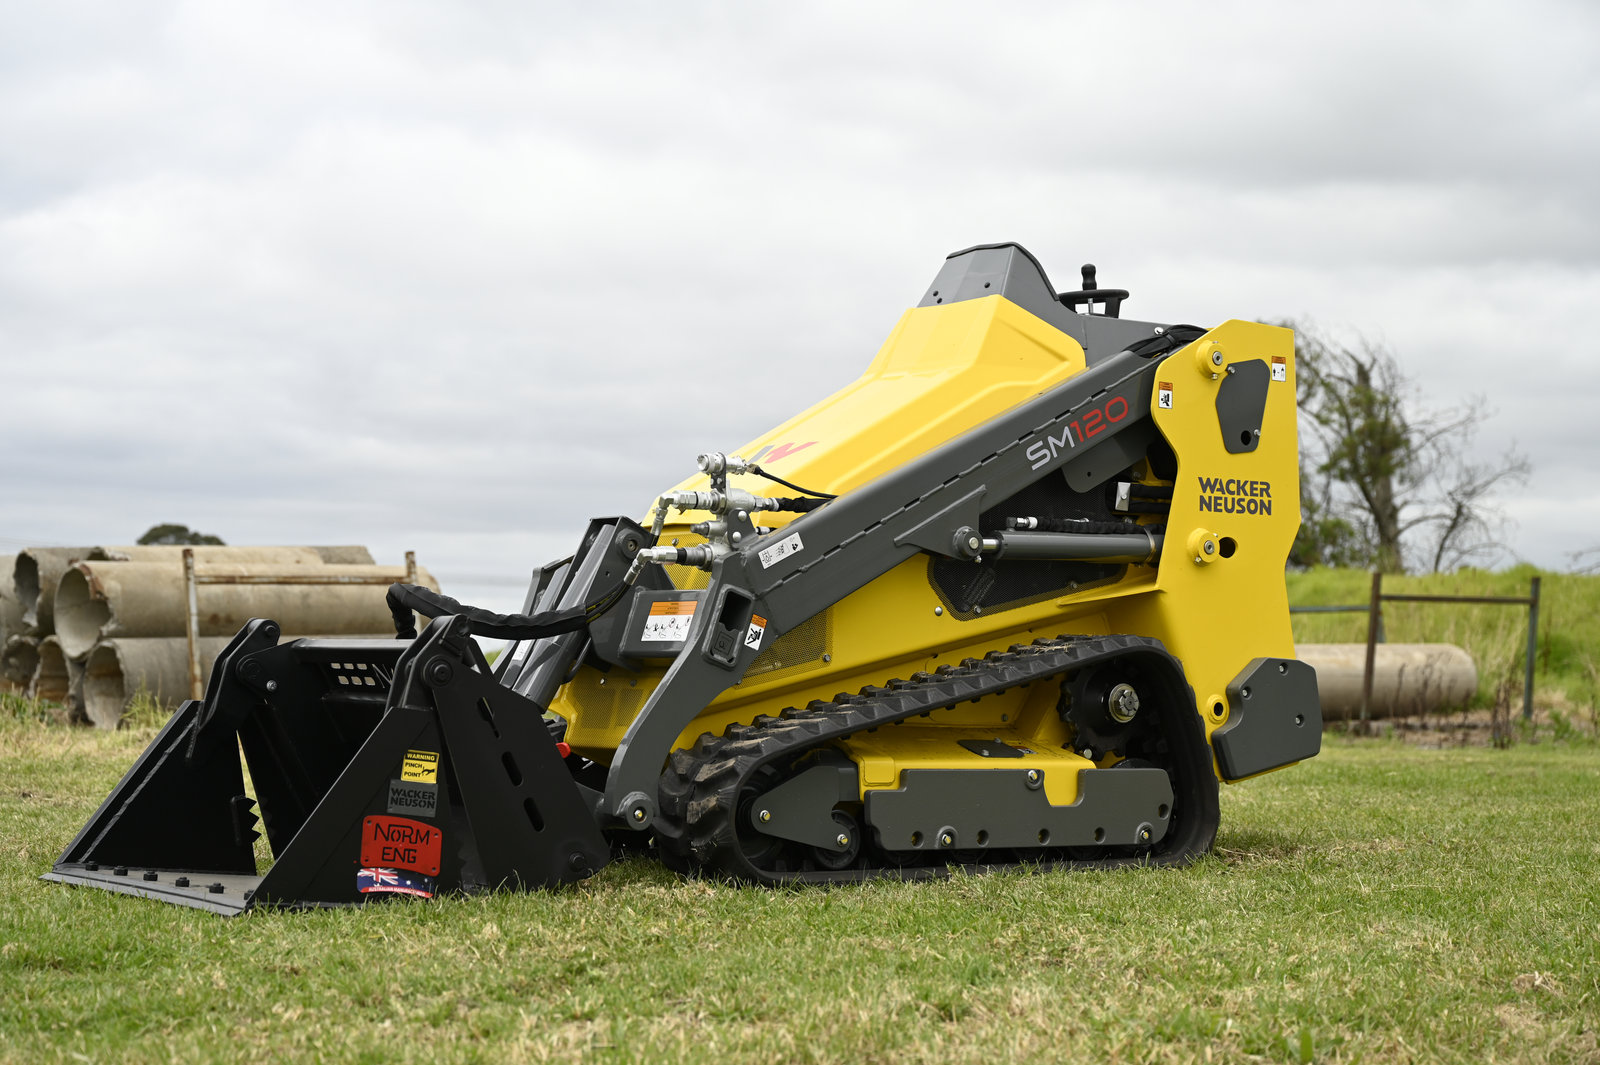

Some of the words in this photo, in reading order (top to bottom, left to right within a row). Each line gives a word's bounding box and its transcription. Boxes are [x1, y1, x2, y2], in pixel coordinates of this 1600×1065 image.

[1026, 396, 1129, 470] SM120
[1198, 476, 1271, 498] WACKER
[1199, 495, 1272, 516] NEUSON
[407, 753, 435, 761] WARNING
[391, 788, 435, 800] WACKER
[390, 797, 435, 809] NEUSON
[381, 847, 417, 864] ENG
